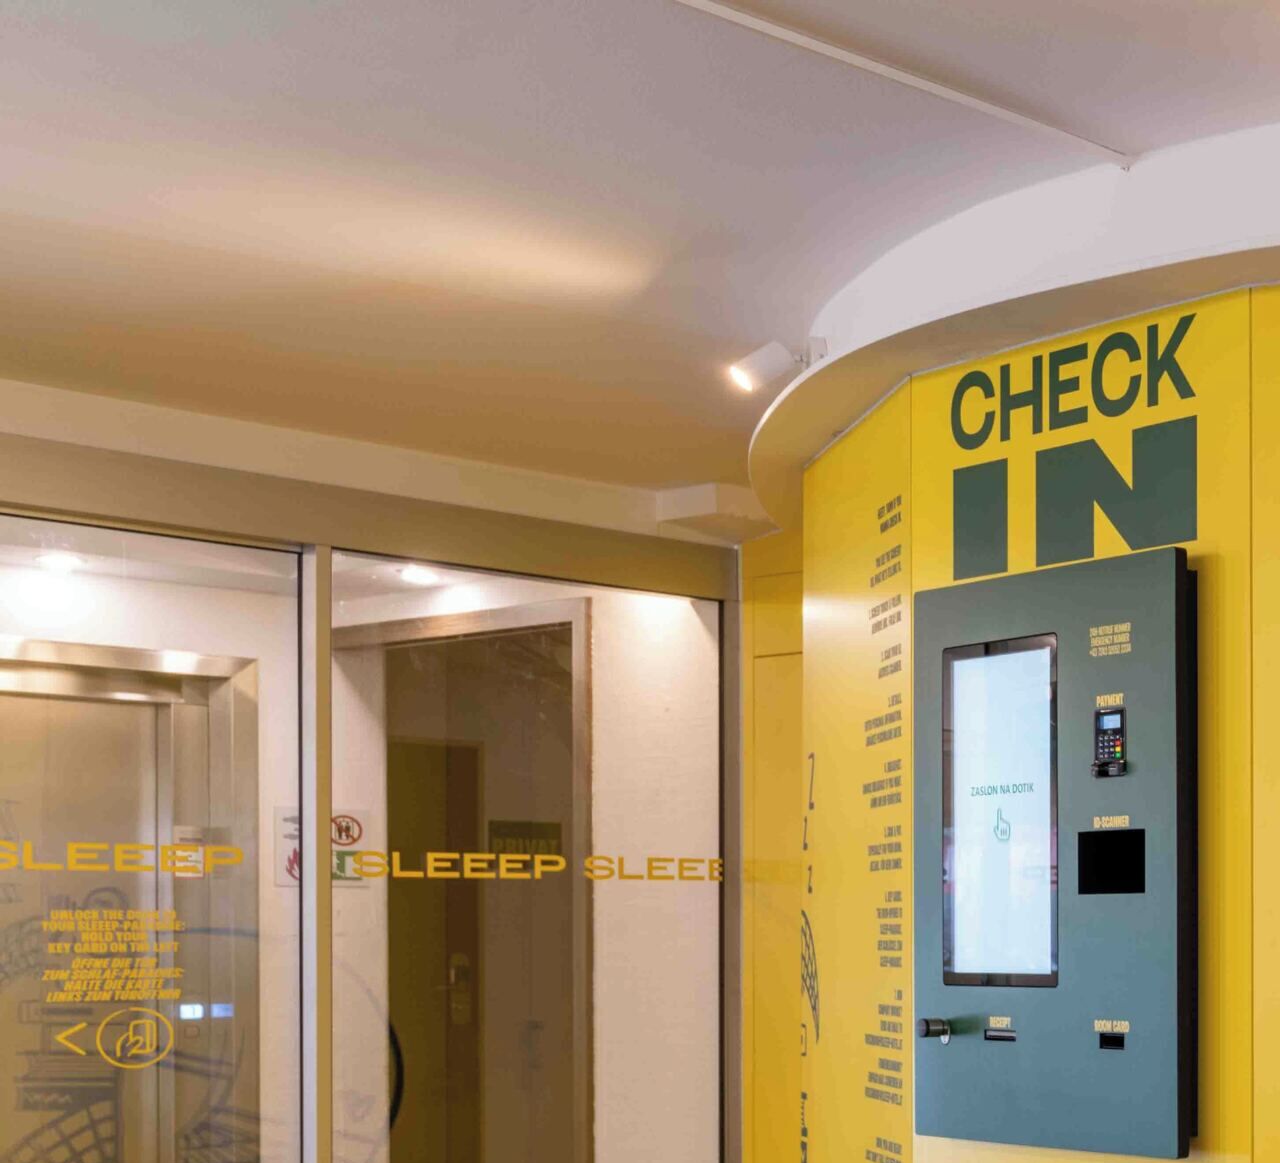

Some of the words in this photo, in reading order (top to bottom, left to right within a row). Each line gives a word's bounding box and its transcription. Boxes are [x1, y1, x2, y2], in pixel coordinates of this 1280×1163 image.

[951, 314, 1196, 450] CHECK
[953, 416, 1197, 580] IN
[1096, 693, 1124, 707] PAYMENT
[970, 785, 998, 797] ZASLON
[1000, 784, 1011, 794] NA
[1012, 783, 1034, 794] DOTIK
[352, 850, 566, 880] SLEEEP
[80, 932, 113, 942] HOLD
[116, 932, 147, 942] YOUR
[48, 943, 70, 953] KEY
[74, 943, 107, 953] CARD
[110, 943, 128, 953] ON
[103, 979, 124, 990] DIE
